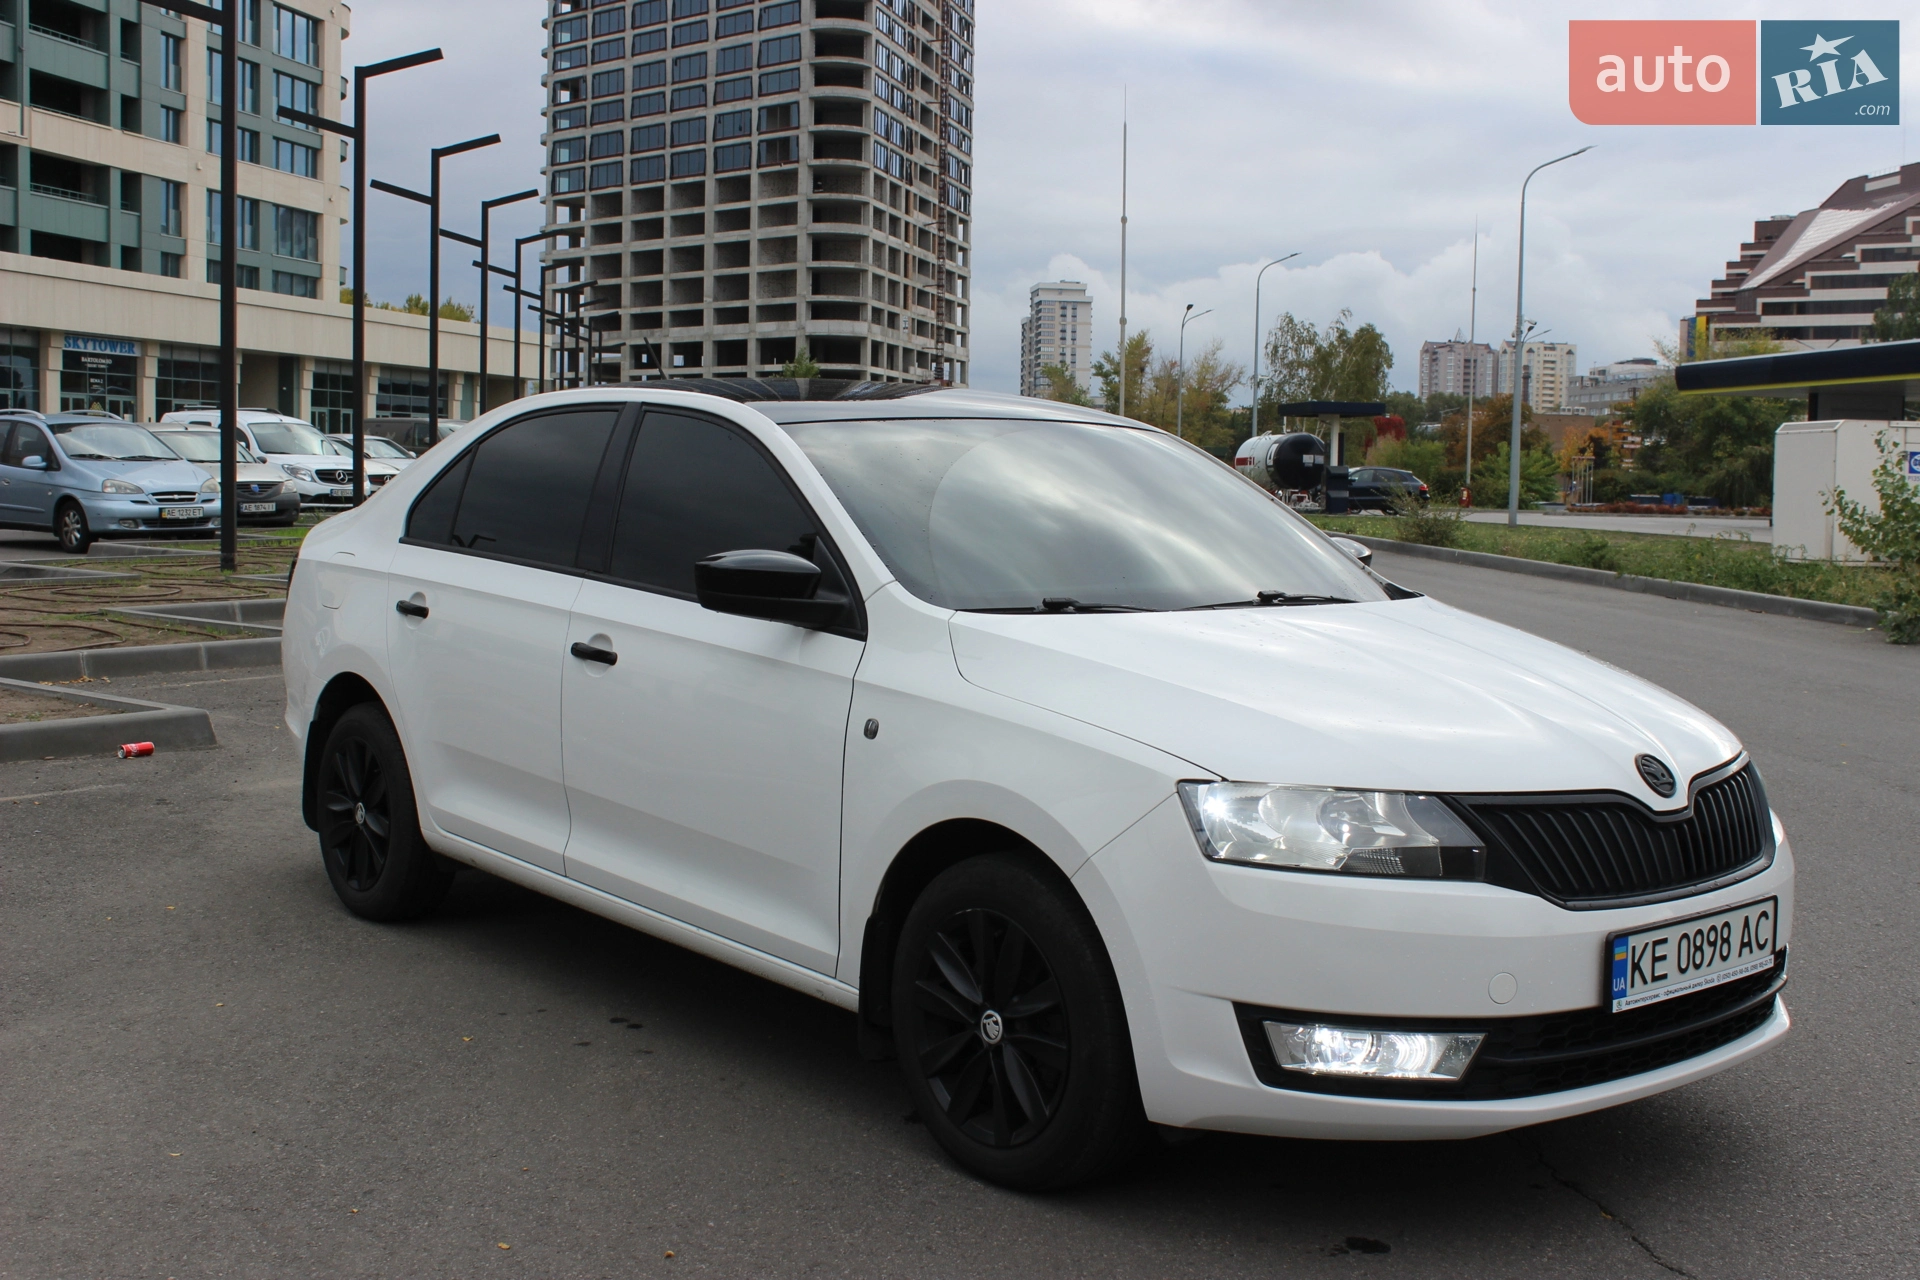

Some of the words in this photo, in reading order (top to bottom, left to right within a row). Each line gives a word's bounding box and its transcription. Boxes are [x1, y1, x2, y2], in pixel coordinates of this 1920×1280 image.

[64, 336, 135, 354] SKYTOWER
[177, 508, 192, 516] 1232
[192, 508, 202, 516] ET
[1630, 936, 1669, 989] KE
[1677, 920, 1732, 975] 0898
[1738, 910, 1770, 958] AC
[1613, 976, 1626, 992] UA
